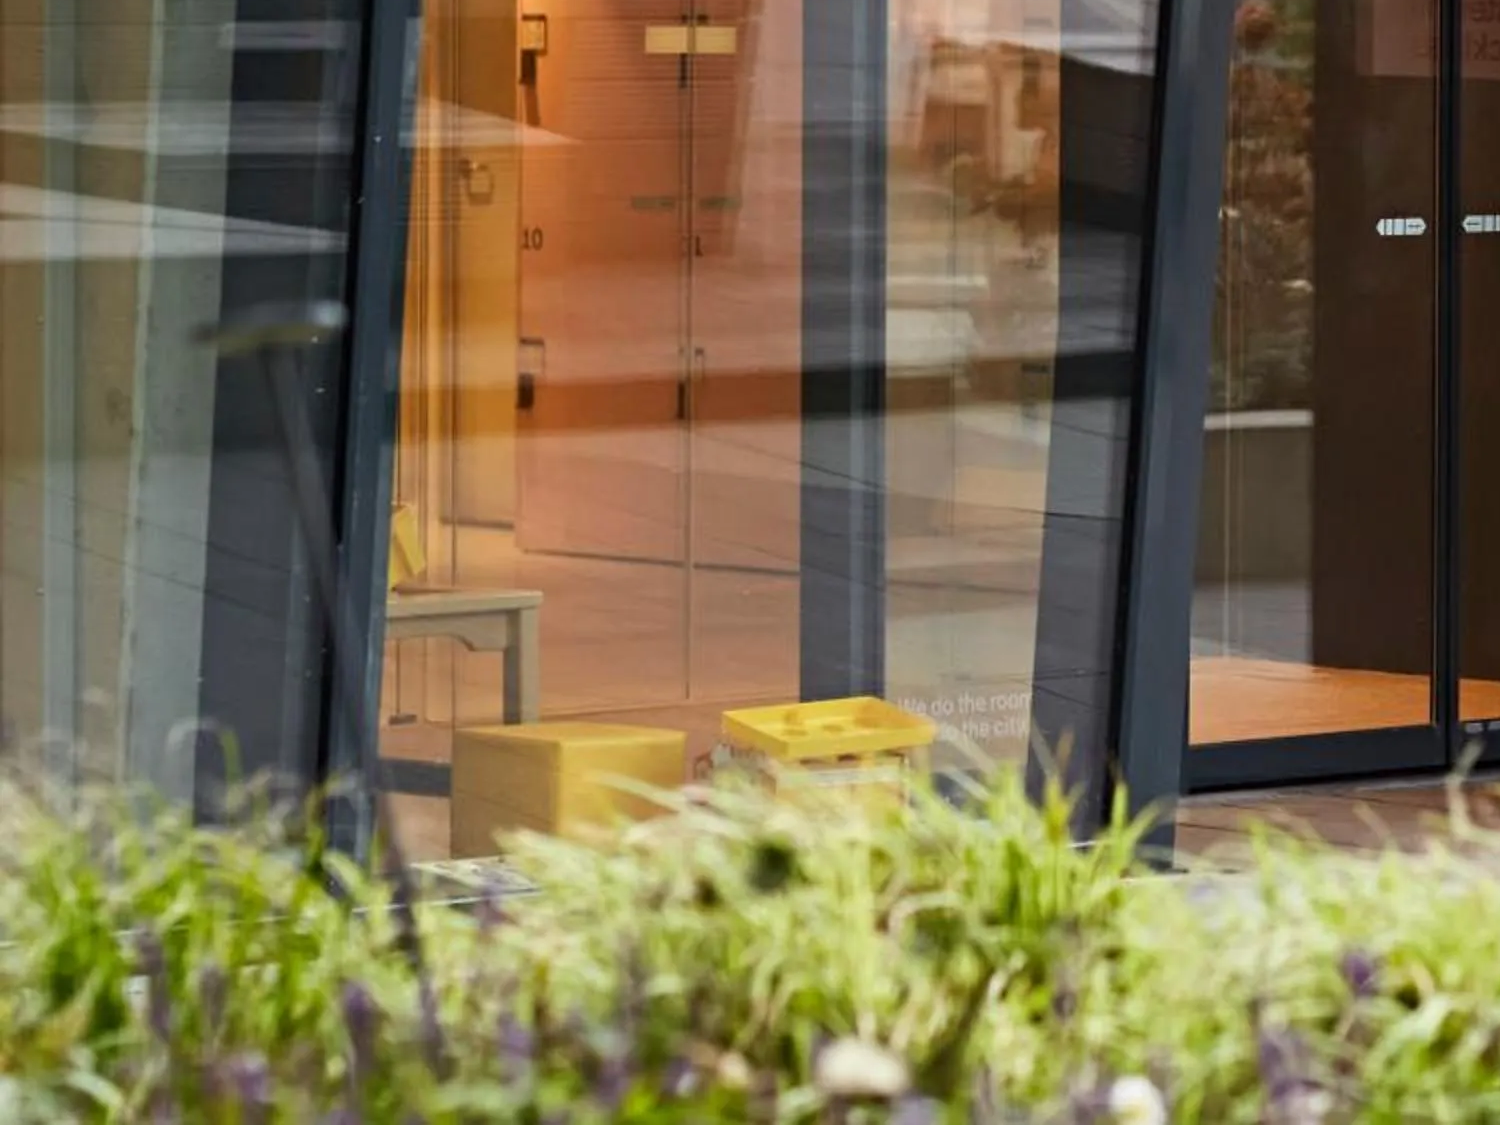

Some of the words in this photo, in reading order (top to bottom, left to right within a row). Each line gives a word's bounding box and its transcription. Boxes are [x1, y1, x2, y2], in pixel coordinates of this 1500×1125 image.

[521, 227, 543, 251] 10
[931, 696, 955, 718] do
[957, 691, 987, 714] the
[962, 718, 989, 740] the
